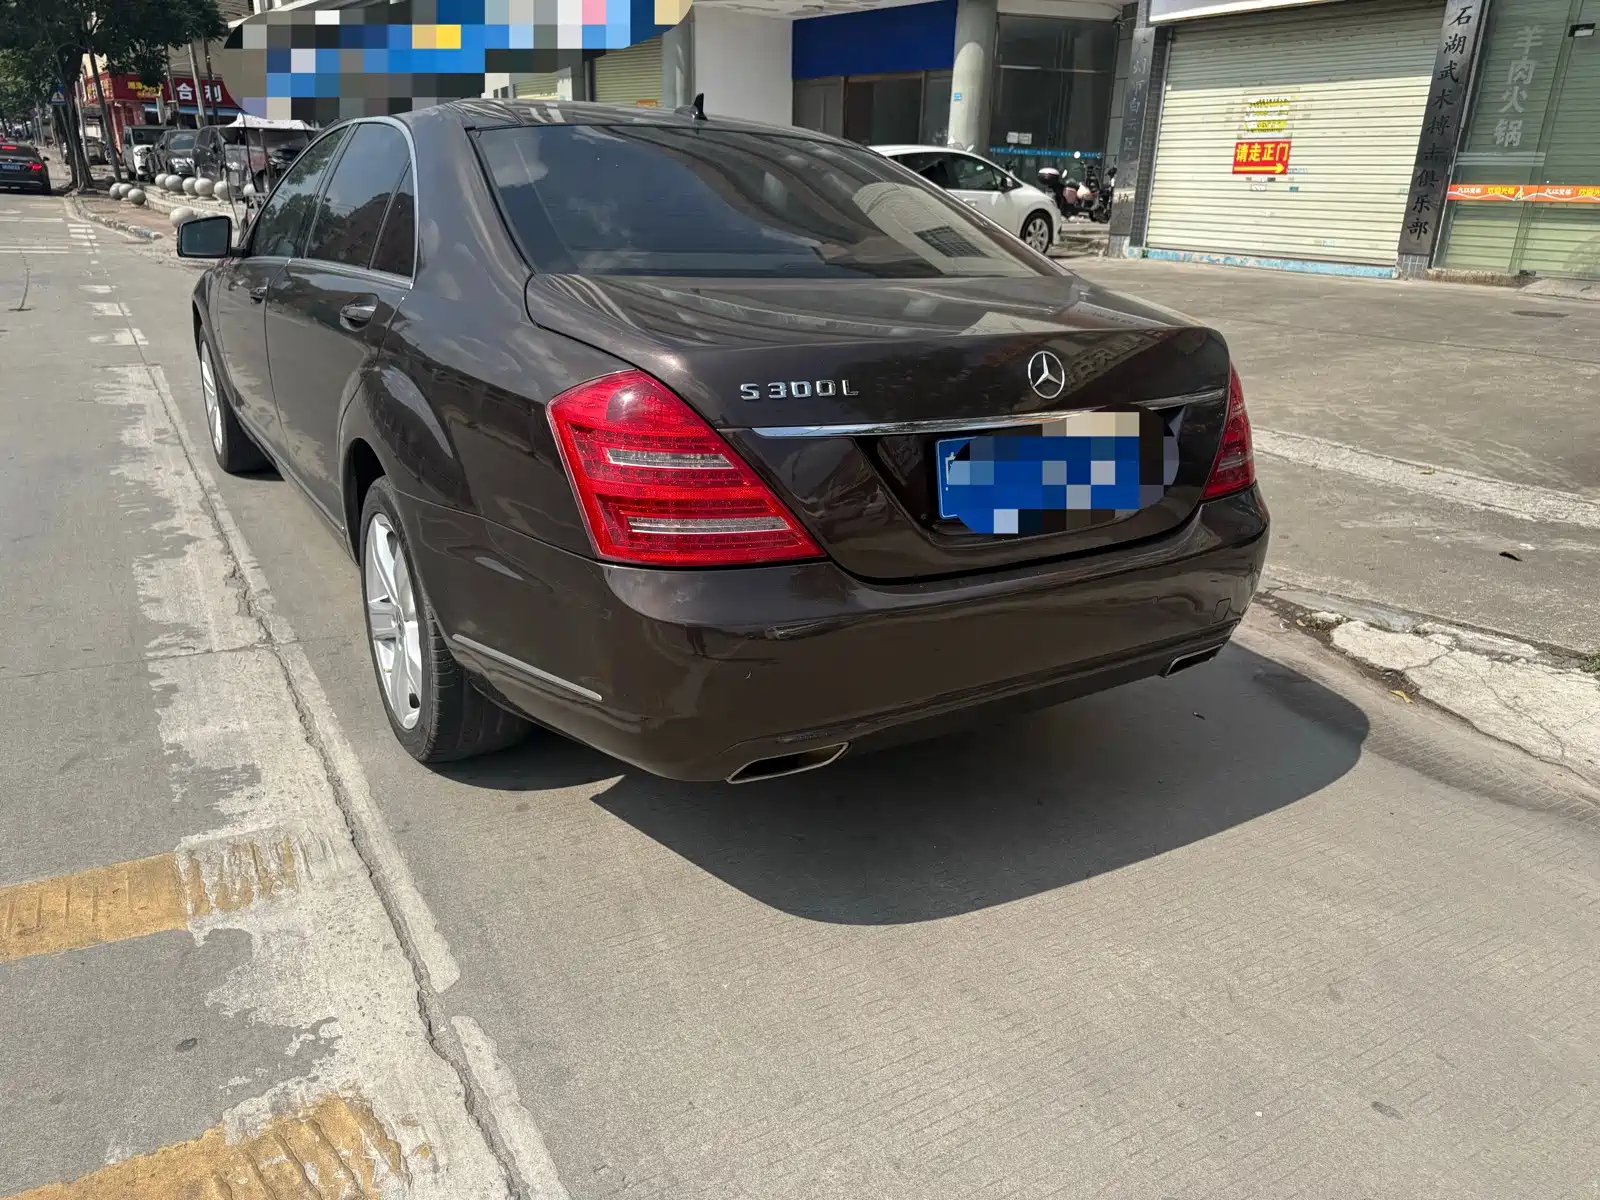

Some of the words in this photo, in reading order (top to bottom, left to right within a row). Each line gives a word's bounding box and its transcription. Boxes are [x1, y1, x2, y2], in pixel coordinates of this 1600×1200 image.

[1493, 25, 1545, 147] 羊肉火锅
[1236, 142, 1289, 163] 请走正门
[1407, 5, 1473, 241] 石湖武术搏击俱乐部
[740, 379, 860, 400] S300L
